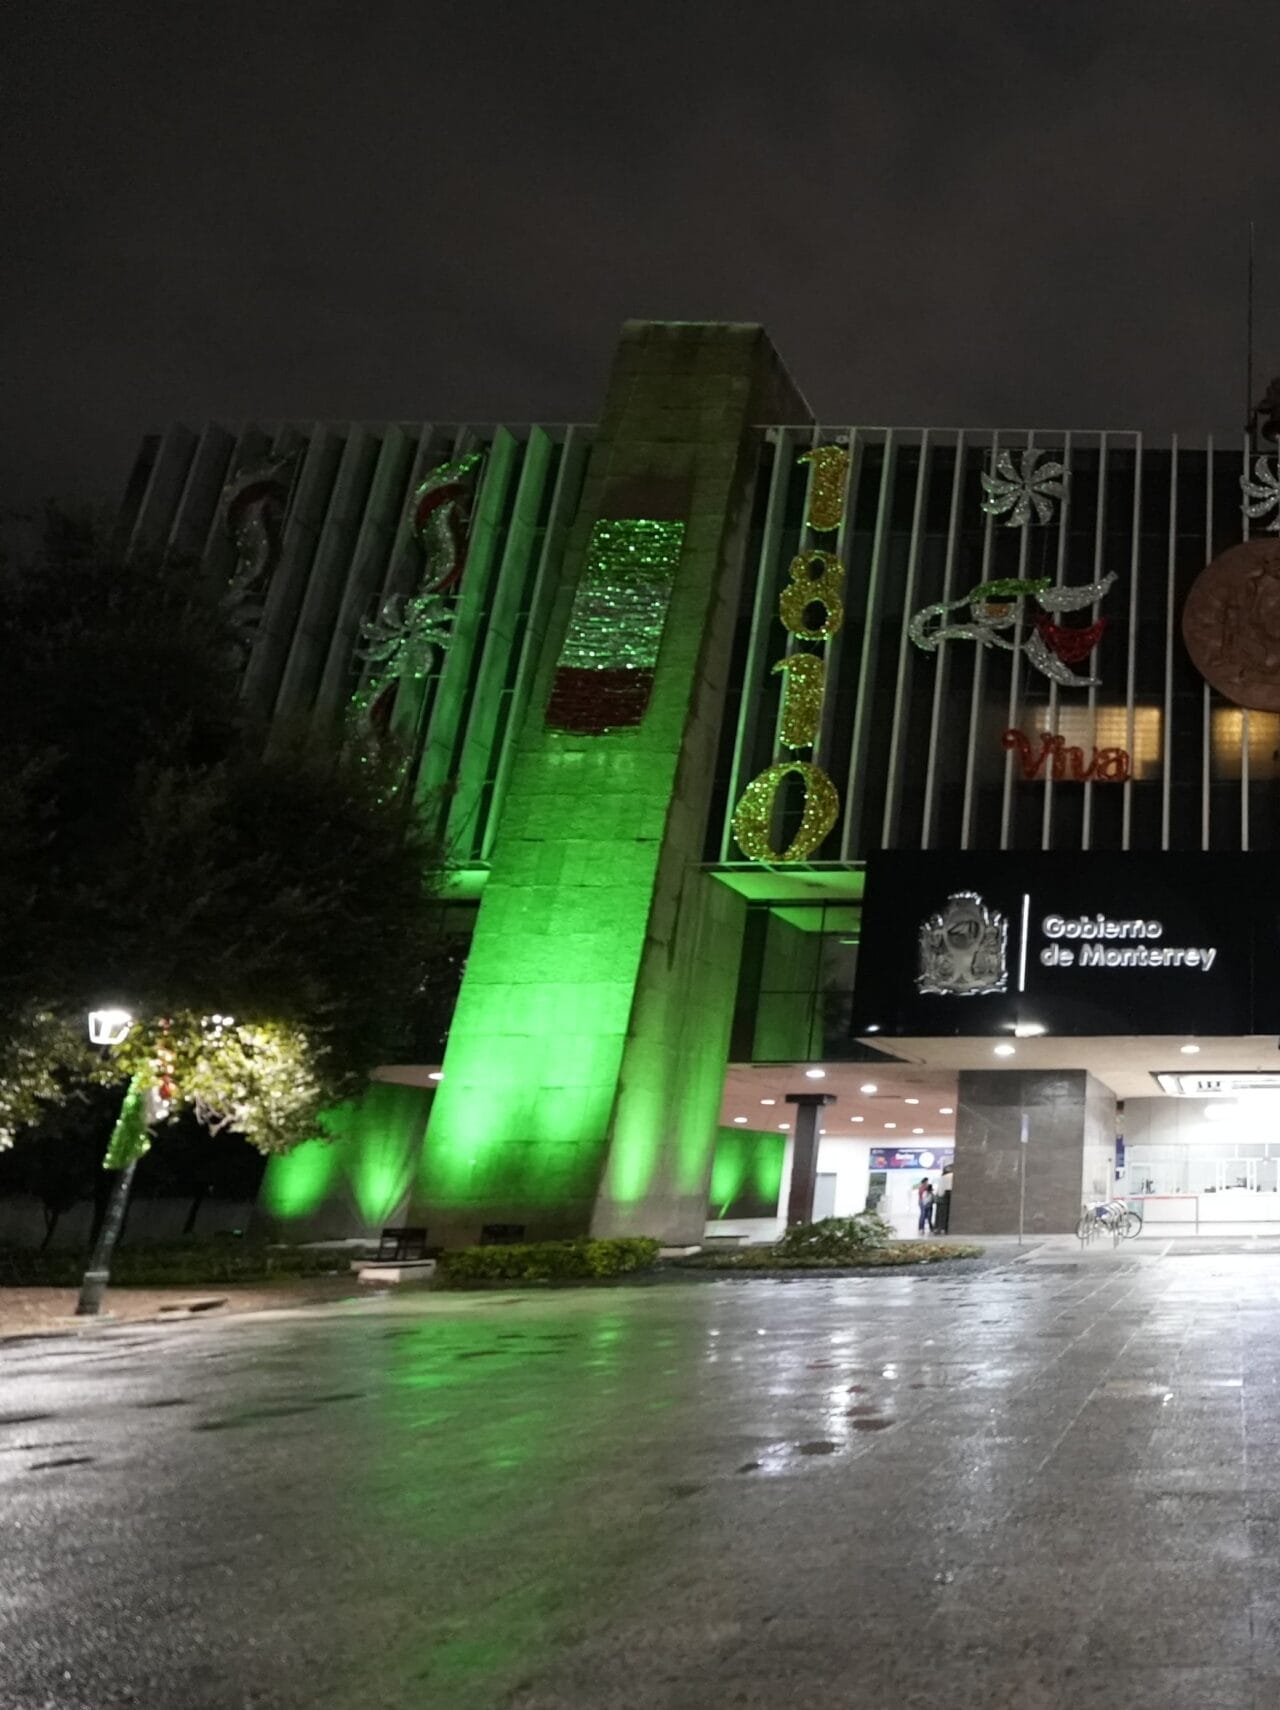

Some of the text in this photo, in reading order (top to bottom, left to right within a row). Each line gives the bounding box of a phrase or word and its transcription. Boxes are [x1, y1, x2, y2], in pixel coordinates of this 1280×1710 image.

[731, 446, 850, 864] 1810
[1001, 729, 1130, 782] Viva
[1042, 913, 1163, 939] Gobierno
[1040, 943, 1217, 972] de Monterrey
